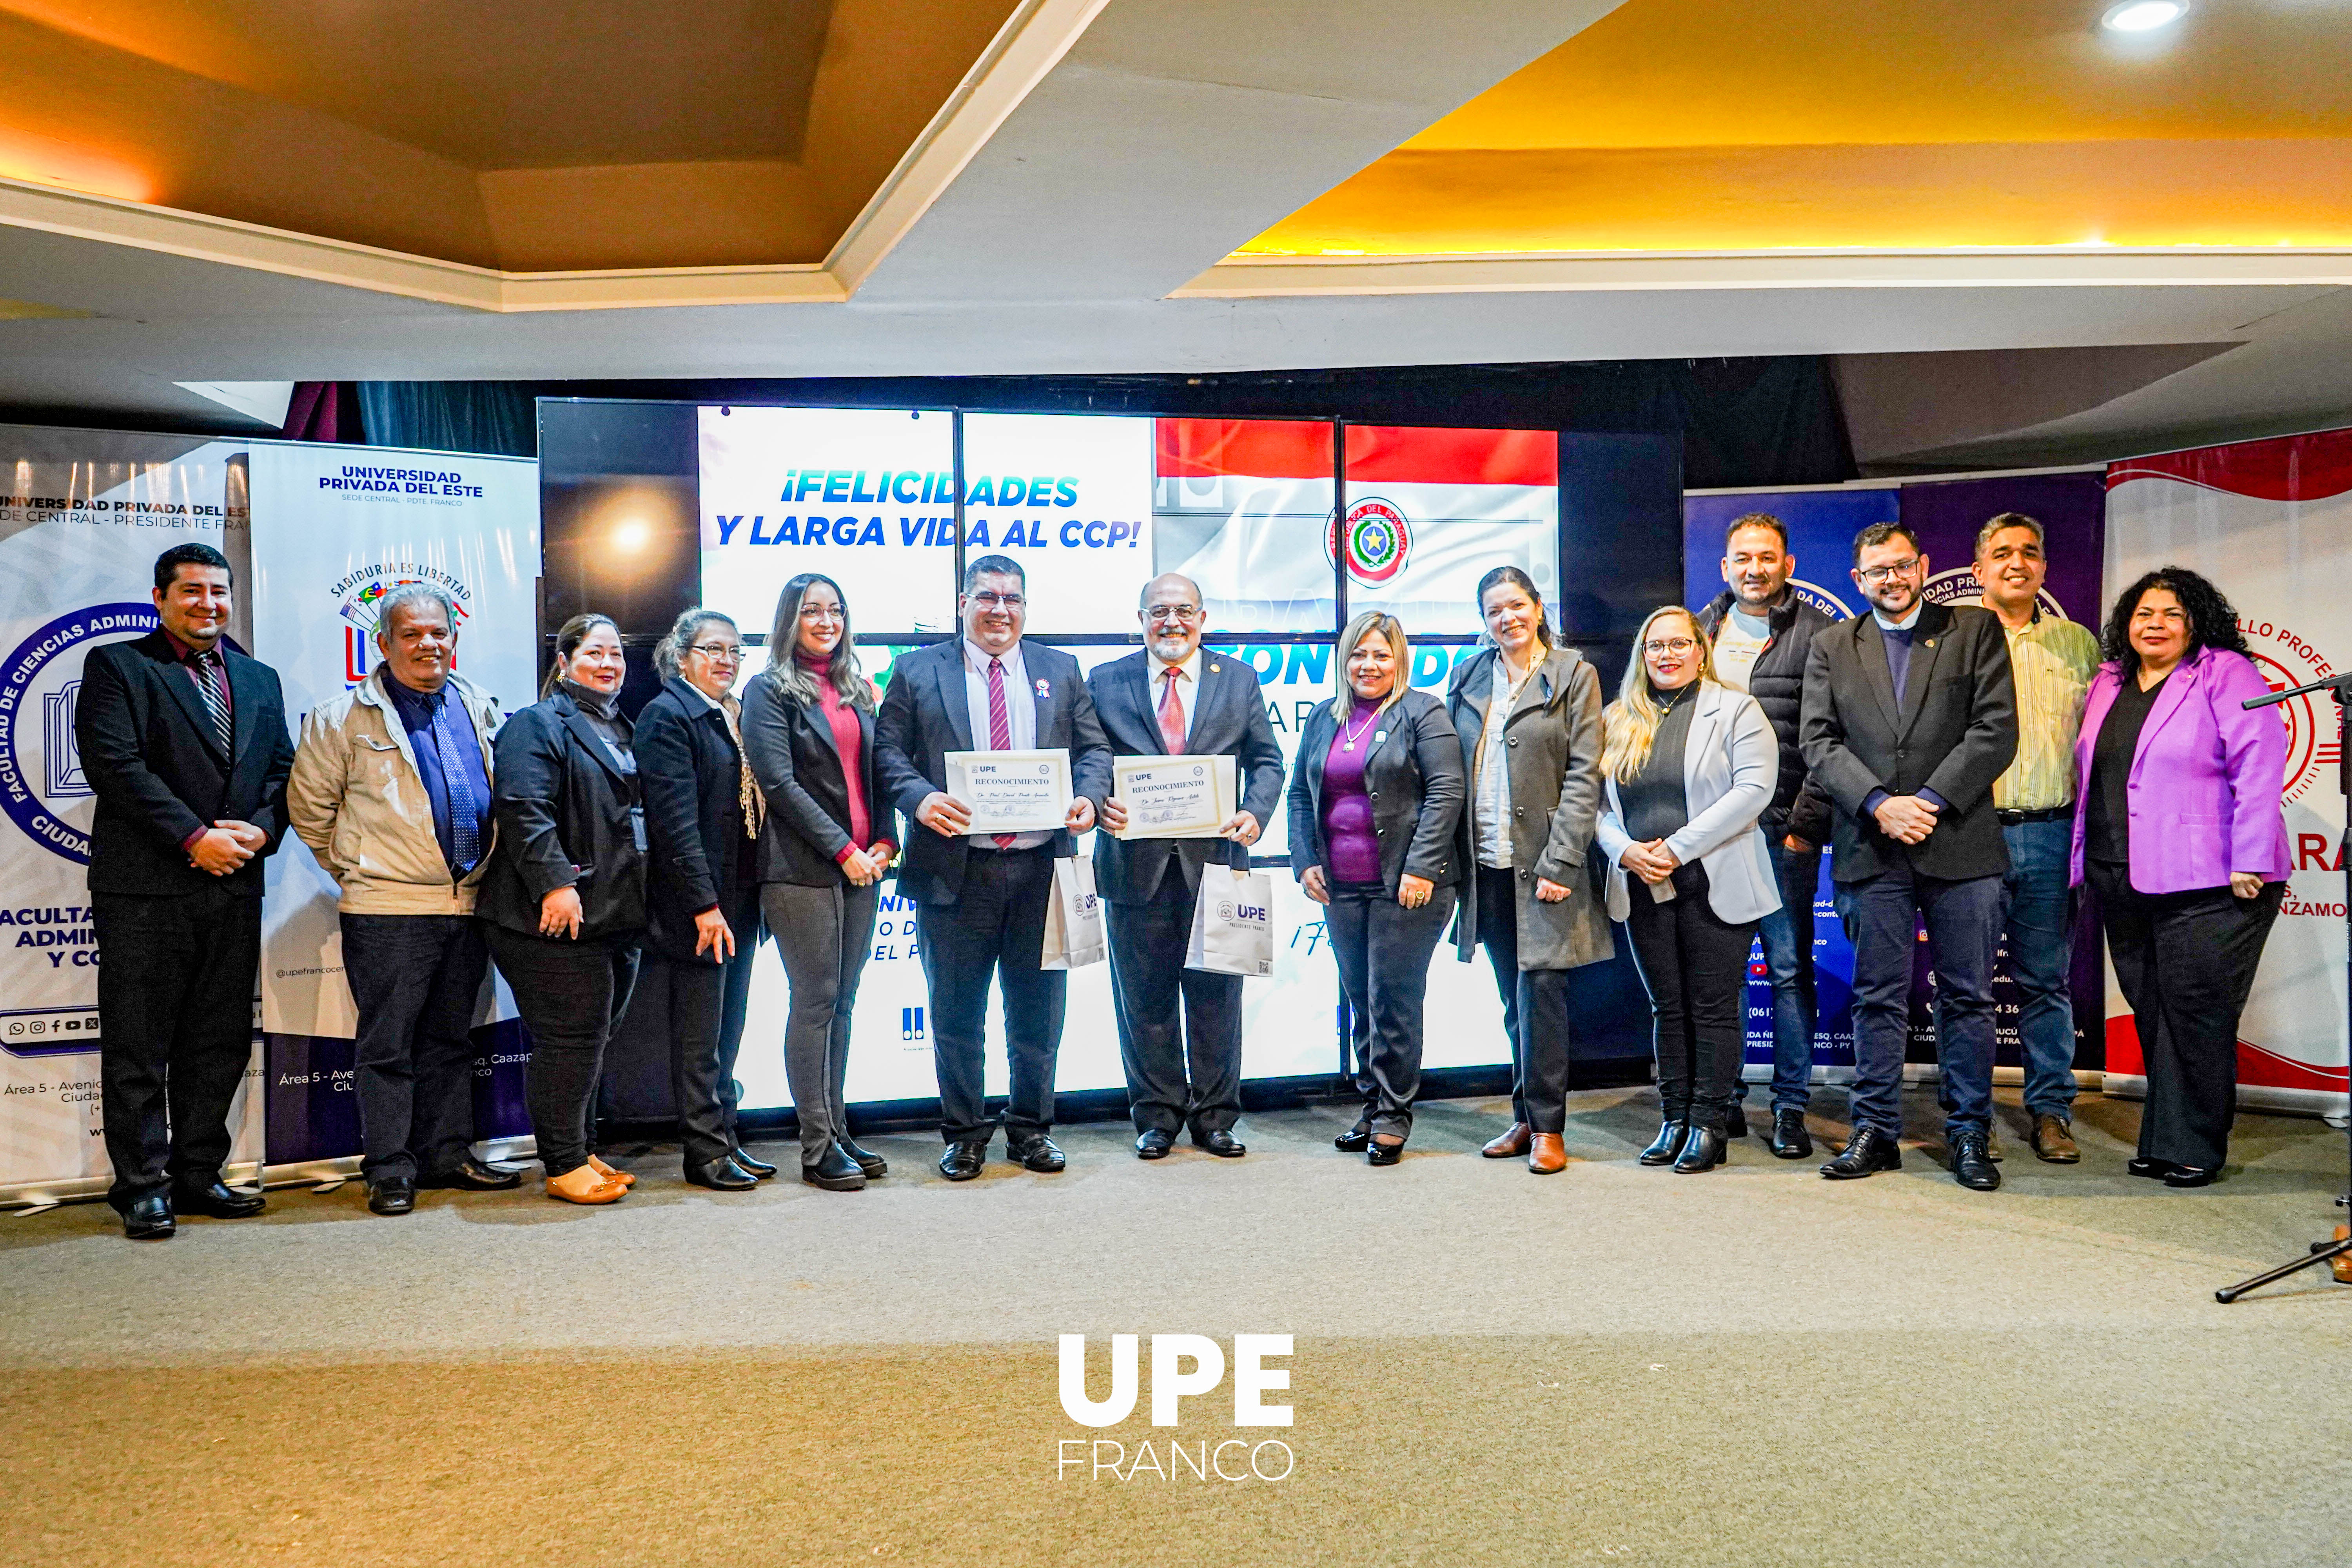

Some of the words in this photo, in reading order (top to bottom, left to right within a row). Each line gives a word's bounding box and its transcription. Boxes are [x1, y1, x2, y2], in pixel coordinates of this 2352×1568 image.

[342, 466, 461, 483] UNIVERSIDAD
[319, 477, 400, 492] PRIVADA
[405, 482, 438, 495] DEL
[443, 485, 483, 497] ESTE
[114, 501, 188, 514] PRIVADA
[193, 505, 223, 516] DEL
[1367, 505, 1381, 513] DEL
[27, 511, 100, 524] CENTRAL
[115, 514, 210, 529] PRESIDENTE
[717, 515, 744, 545] Y
[750, 516, 886, 546] LARGA
[901, 517, 991, 548] VIDA
[1001, 520, 1047, 548] AL
[1060, 521, 1142, 548] CCP!
[401, 563, 414, 573] ES
[418, 565, 470, 600] LIBERTAD
[3, 686, 18, 710] DE
[12, 624, 84, 684] CIENCIAS
[1132, 780, 1204, 793] RECONOCIMIENTO
[1238, 904, 1265, 921] UPE
[47, 951, 65, 967] Y
[279, 1073, 309, 1085] Área
[312, 1072, 320, 1082] 5
[4, 1084, 35, 1095] Área
[39, 1083, 46, 1093] 5
